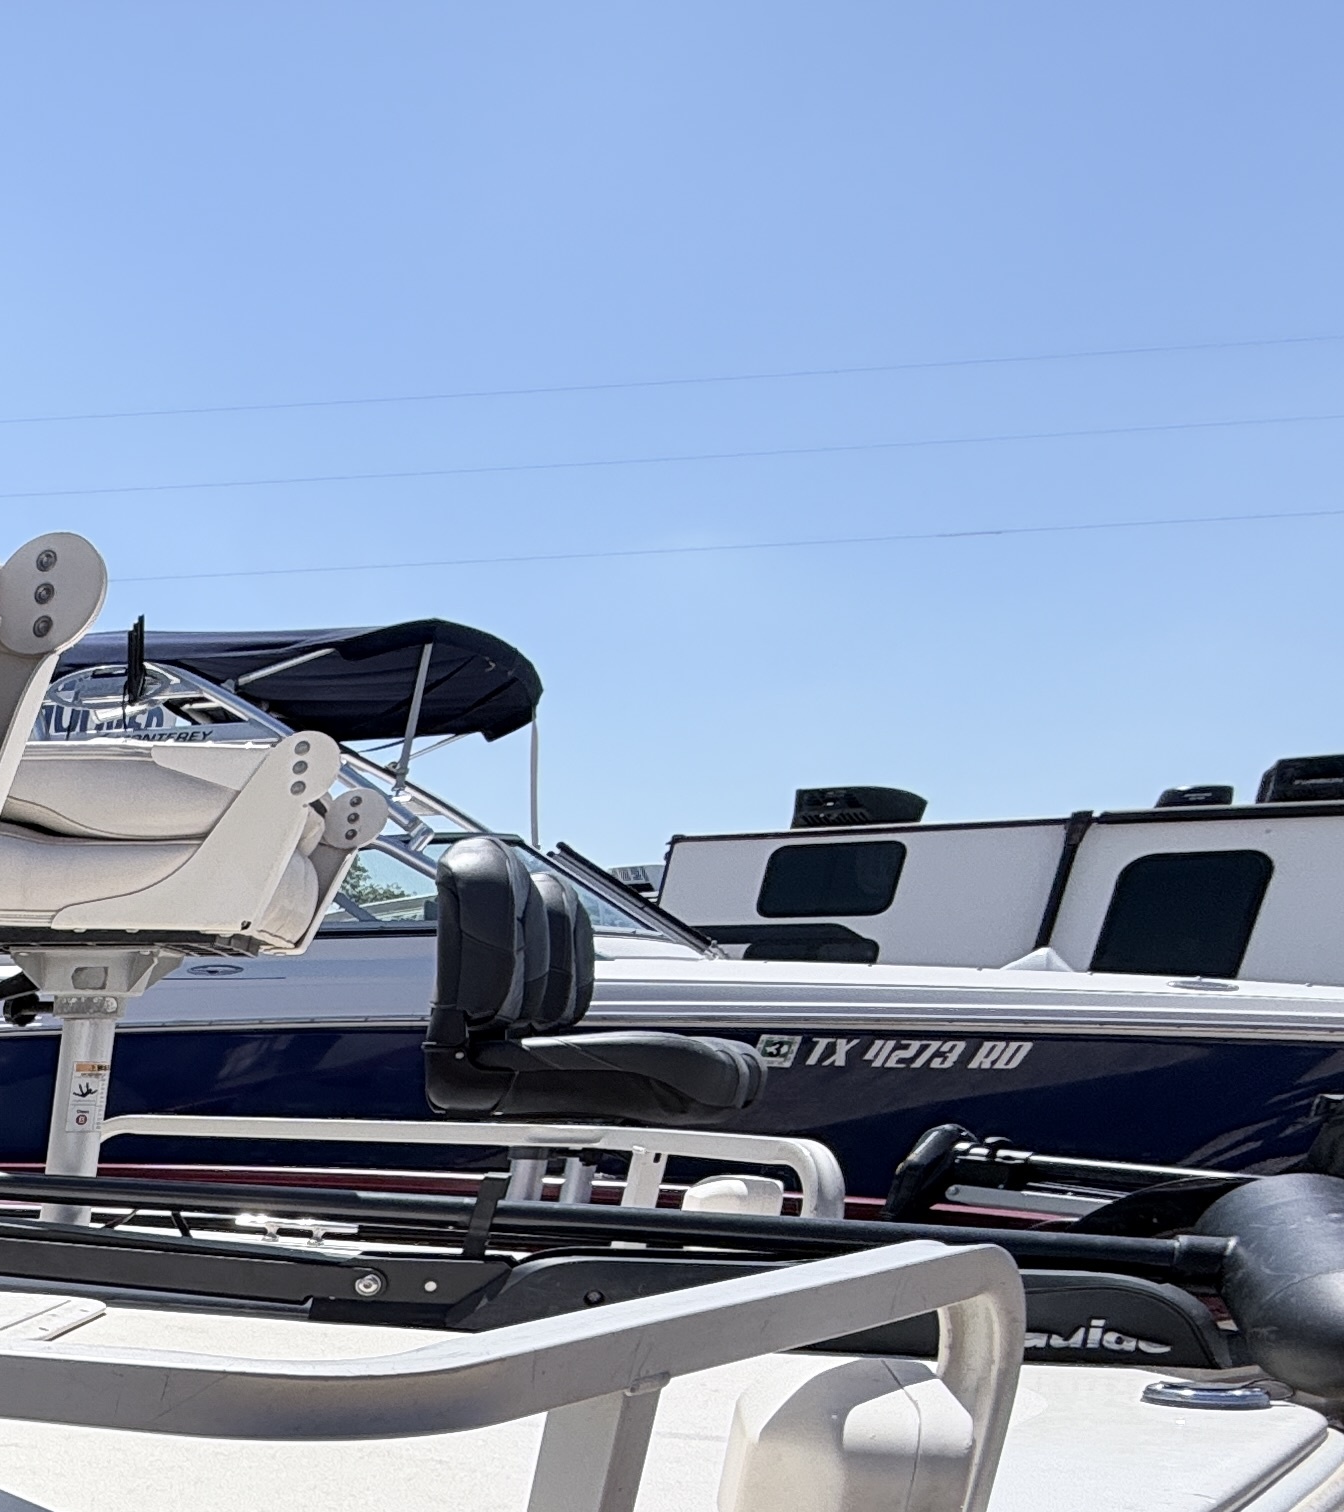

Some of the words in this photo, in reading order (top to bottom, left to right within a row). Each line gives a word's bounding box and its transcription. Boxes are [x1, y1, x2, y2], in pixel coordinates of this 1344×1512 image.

[767, 1040, 785, 1058] 3
[805, 1038, 861, 1067] TX
[863, 1039, 967, 1069] 4273
[967, 1041, 1034, 1070] RD
